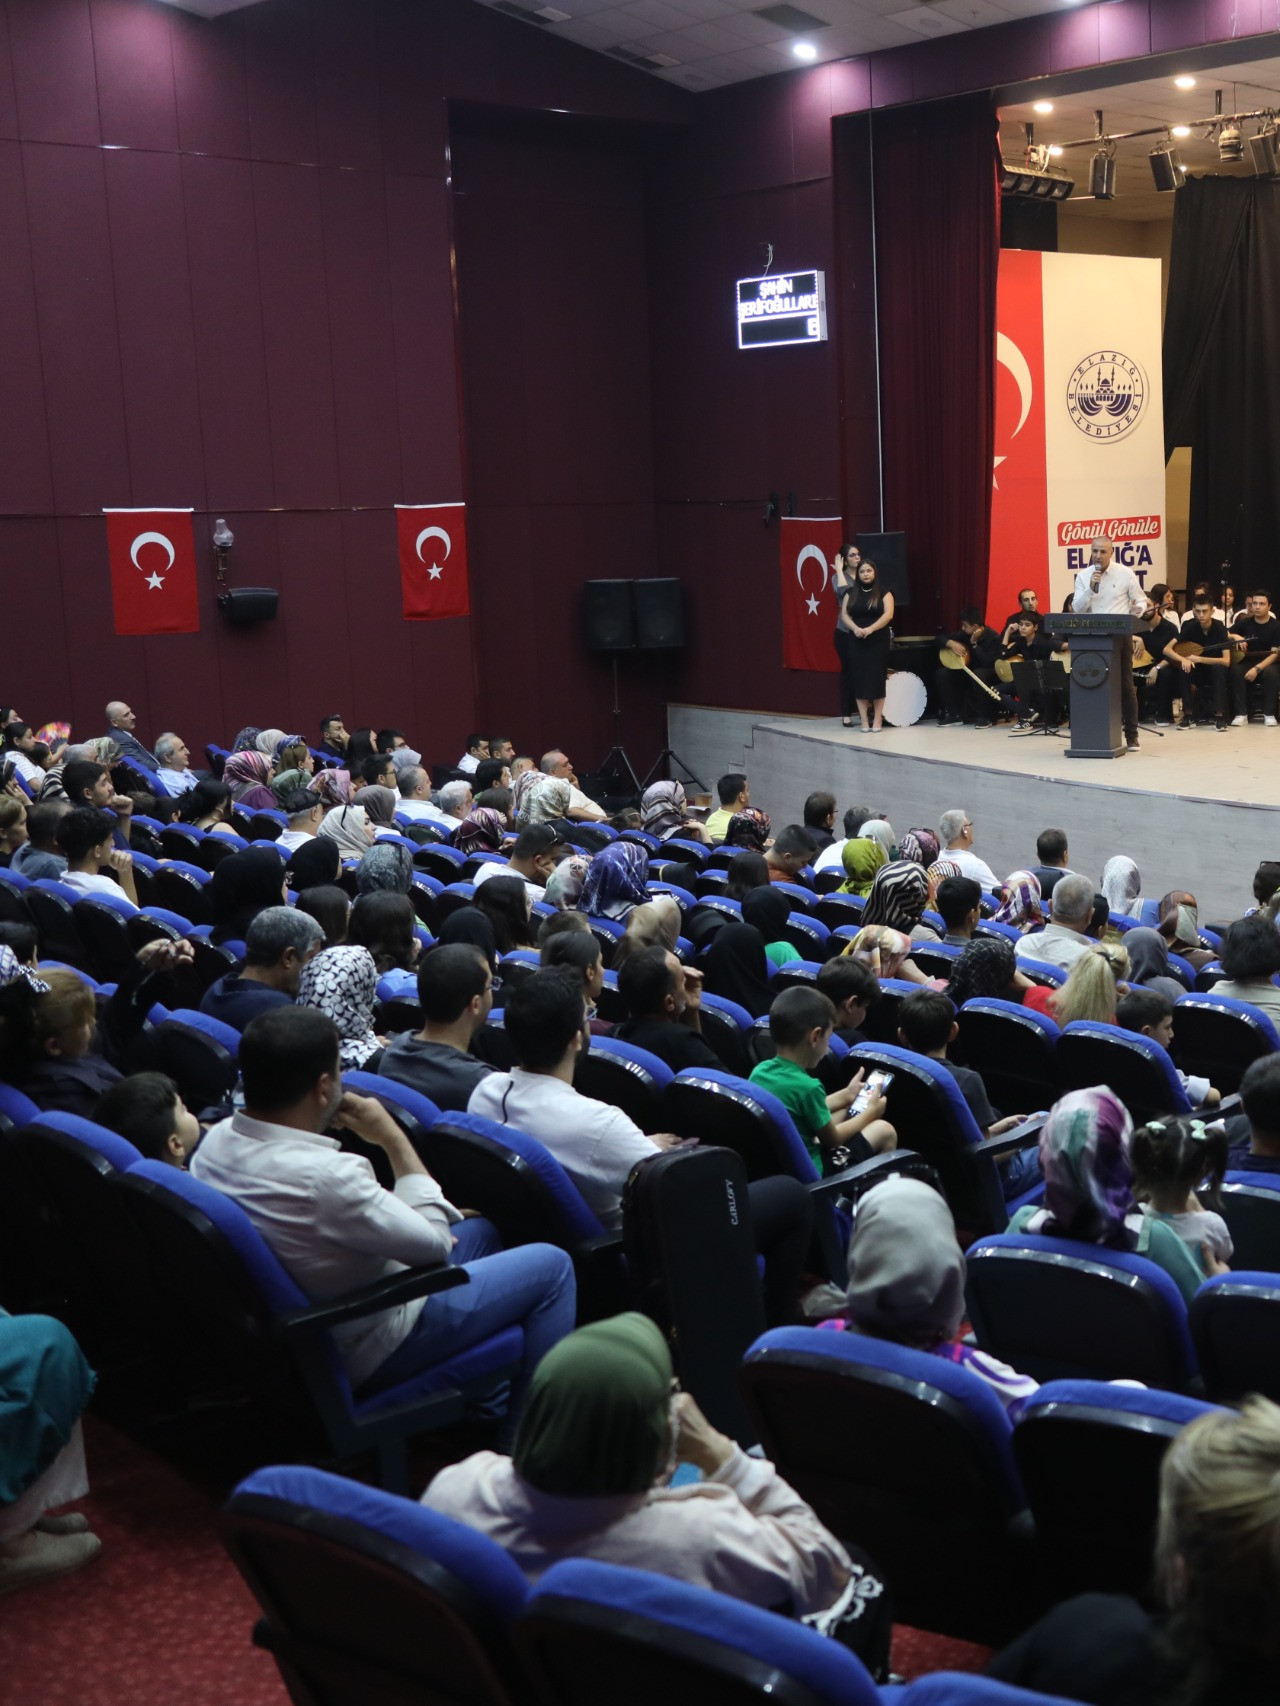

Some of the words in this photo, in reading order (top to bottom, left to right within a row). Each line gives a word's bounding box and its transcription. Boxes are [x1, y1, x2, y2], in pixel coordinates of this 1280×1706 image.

[1076, 353, 1138, 377] ELAZIĞ
[1067, 391, 1144, 437] BELEDİYESİ
[1061, 520, 1107, 545] Gönül
[1108, 516, 1159, 541] Gönüle
[1067, 542, 1153, 570] ELIĞ'A
